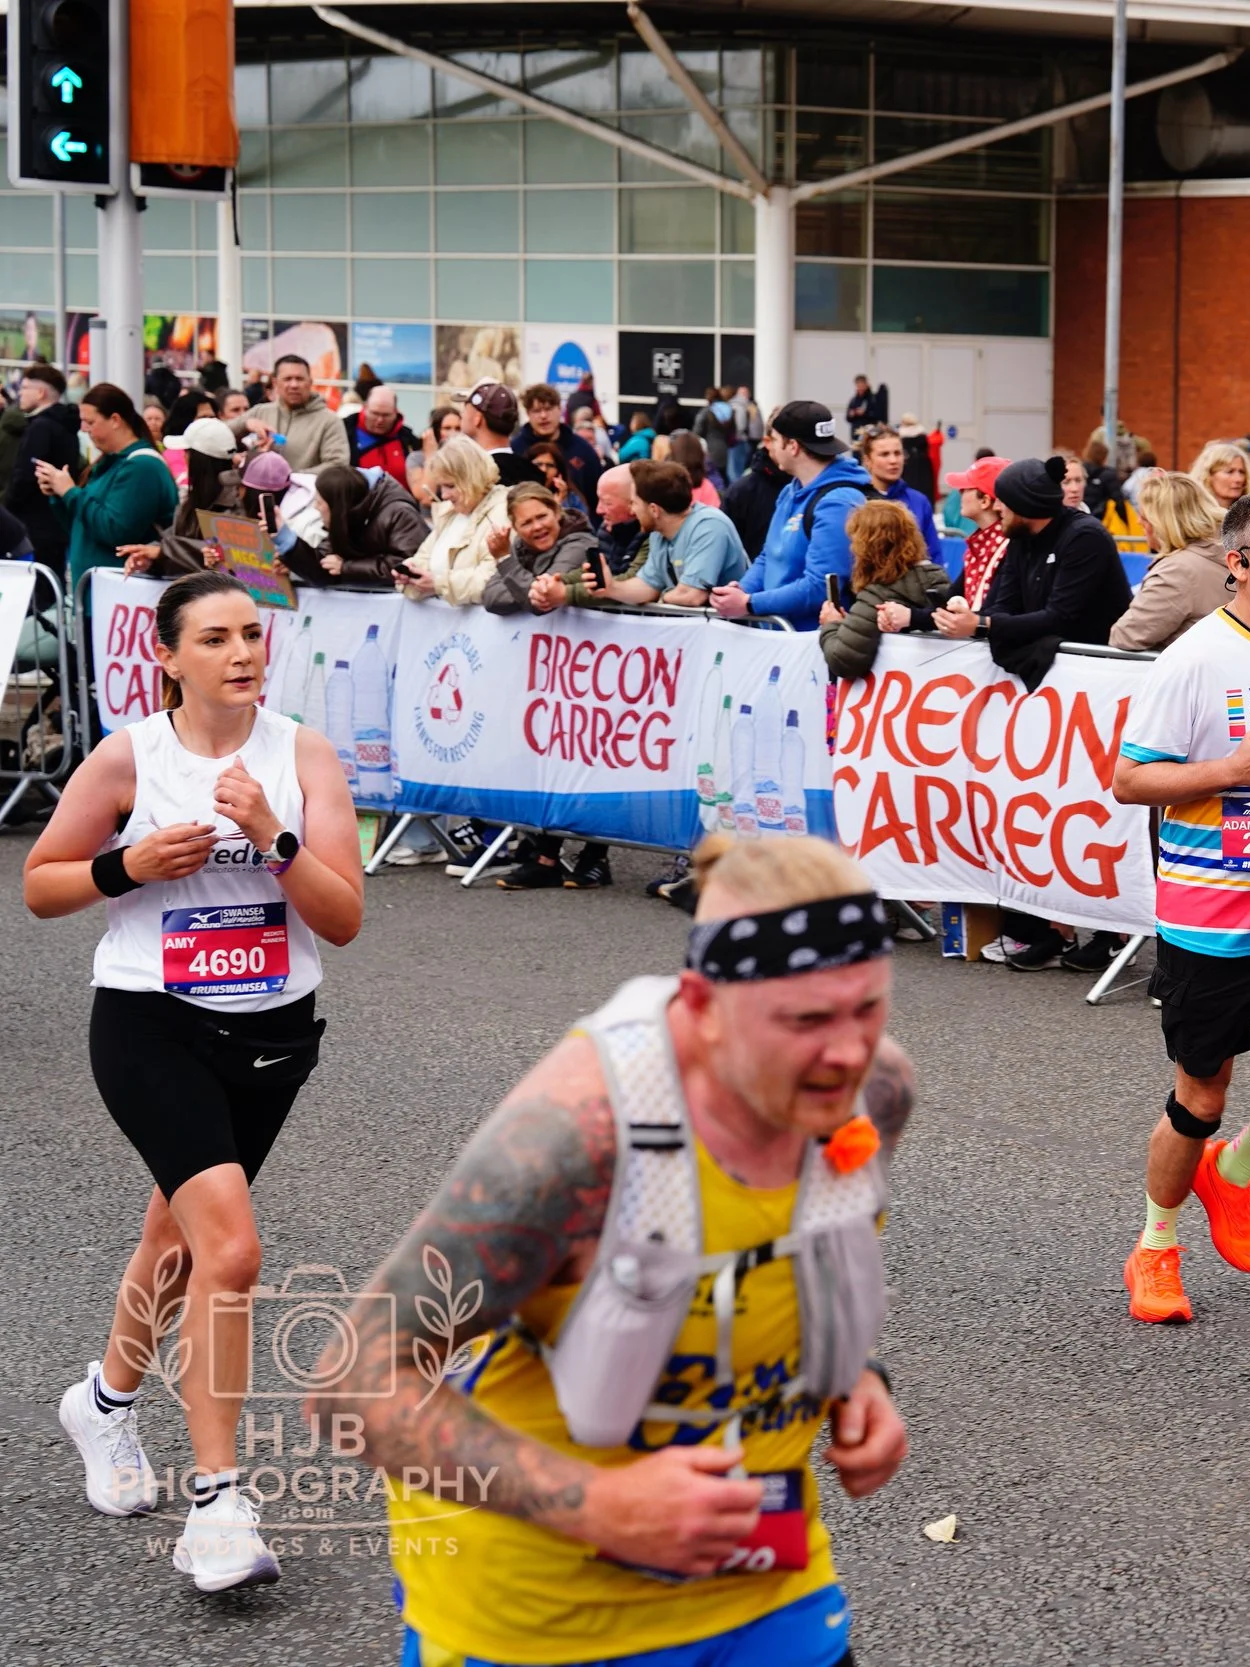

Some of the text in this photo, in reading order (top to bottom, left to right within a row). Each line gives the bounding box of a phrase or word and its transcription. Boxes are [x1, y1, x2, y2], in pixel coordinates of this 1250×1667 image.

[527, 633, 683, 708] BRECON
[523, 697, 677, 773] CARREG
[833, 670, 1132, 792] BRECON
[832, 765, 1129, 900] CARREG
[222, 907, 265, 917] SWANSEA
[164, 936, 197, 950] AMY
[188, 946, 266, 978] 4690
[189, 981, 268, 995] #RUNSWANSEA
